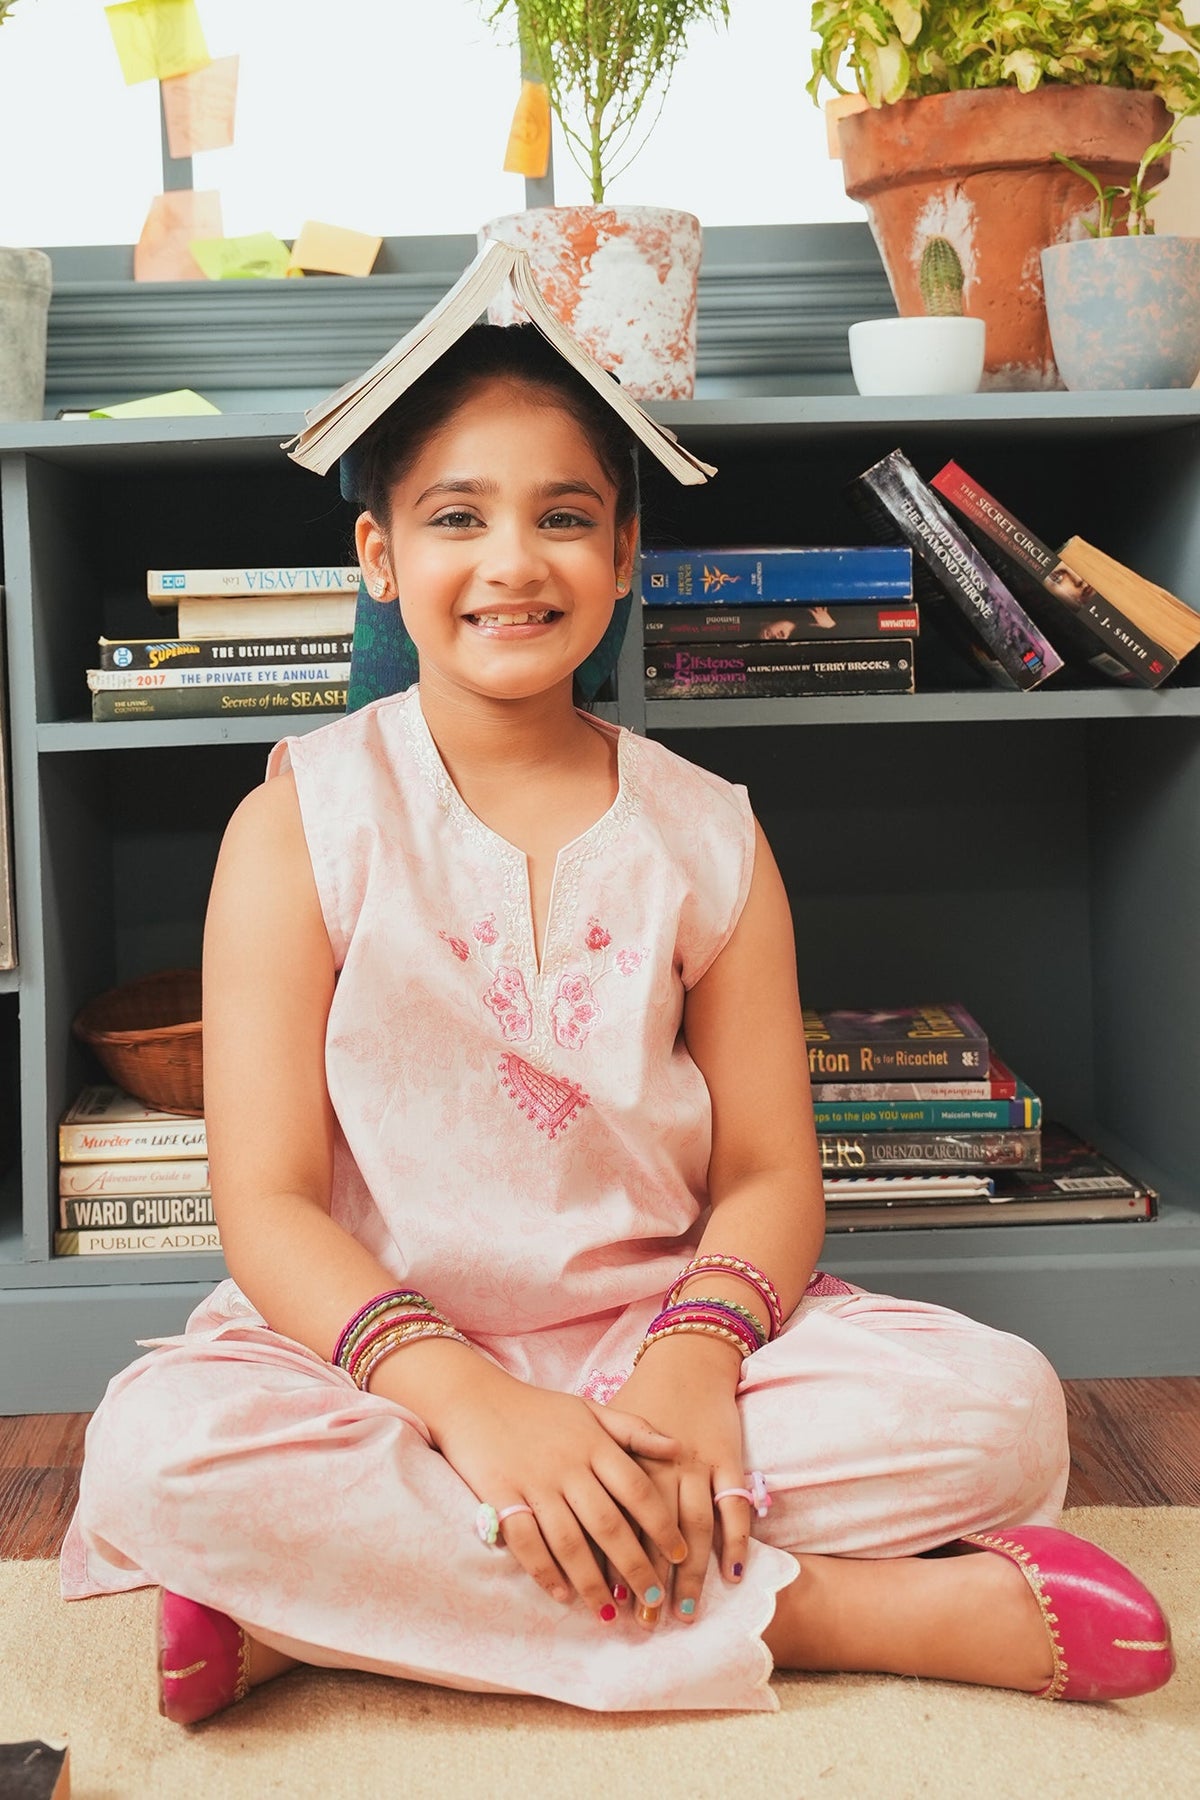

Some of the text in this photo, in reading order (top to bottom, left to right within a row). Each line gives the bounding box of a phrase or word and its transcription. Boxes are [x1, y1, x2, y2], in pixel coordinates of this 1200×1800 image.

[959, 483, 1052, 568] THE SECRET CIRCLE
[900, 499, 994, 620] THE DIAMOND THRONE
[948, 544, 988, 592] EDDINGS
[244, 570, 342, 589] MALAYSIA
[880, 619, 917, 628] GOLDMANN
[1089, 605, 1148, 659] L. J. SMITH
[149, 645, 201, 668] SUPERMAN
[212, 647, 235, 658] THE
[239, 645, 297, 657] ULTIMATE
[301, 642, 338, 655] GUIDE
[813, 660, 890, 672] TERRY BROOKS
[137, 675, 167, 686] 2017
[181, 673, 201, 684] THE
[206, 671, 253, 683] PRIVATE
[258, 671, 278, 681] EYE
[283, 669, 330, 681] ANNUAL
[222, 696, 257, 708] Secrets
[259, 694, 271, 709] of
[272, 694, 289, 706] the
[808, 1048, 850, 1072] fton
[860, 1048, 948, 1072] R is for Ricochet
[833, 1112, 842, 1121] to
[844, 1111, 859, 1120] the
[862, 1111, 876, 1122] job
[879, 1111, 898, 1119] YOU
[901, 1111, 924, 1119] want
[941, 1111, 997, 1119] Malcolm Hornby
[80, 1135, 133, 1149] Murder
[152, 1135, 178, 1145] LAKE
[822, 1138, 865, 1168] ERS
[872, 1144, 923, 1159] LORENZO
[70, 1171, 147, 1193] Adventure
[150, 1171, 179, 1180] Guide
[74, 1198, 216, 1226] WARD CHURCHI
[90, 1234, 221, 1250] PUBLIC ADDR
